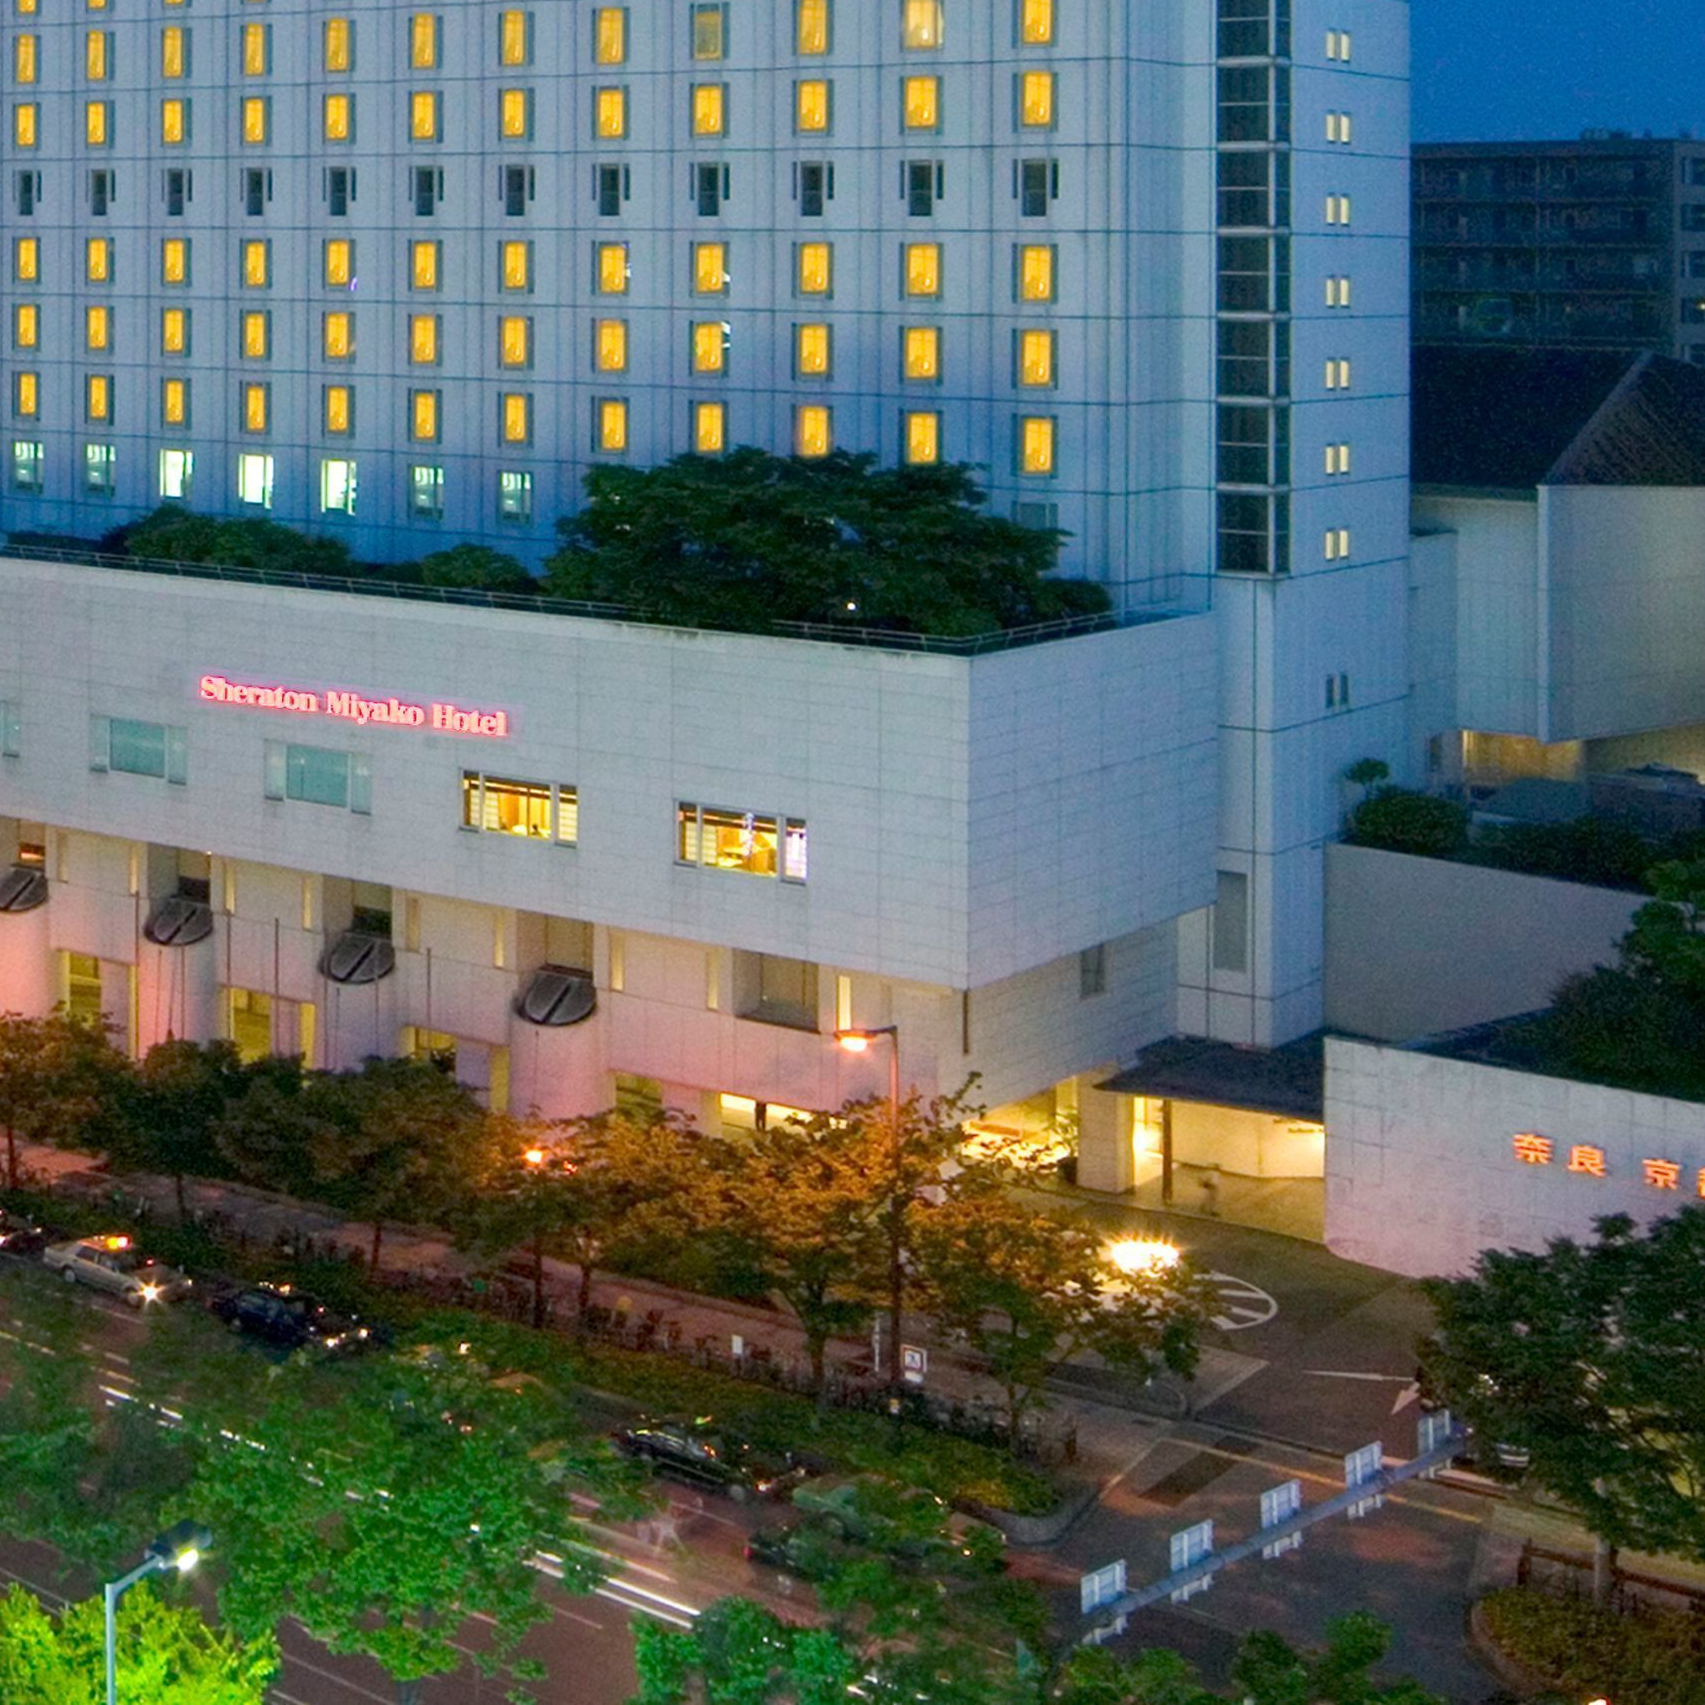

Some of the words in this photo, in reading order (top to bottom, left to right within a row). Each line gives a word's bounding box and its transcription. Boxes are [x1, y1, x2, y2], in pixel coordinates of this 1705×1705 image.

[199, 675, 318, 712] Sheraton
[326, 690, 425, 725] Miyako
[432, 703, 508, 737] Hotel
[1642, 1158, 1705, 1199] 京
